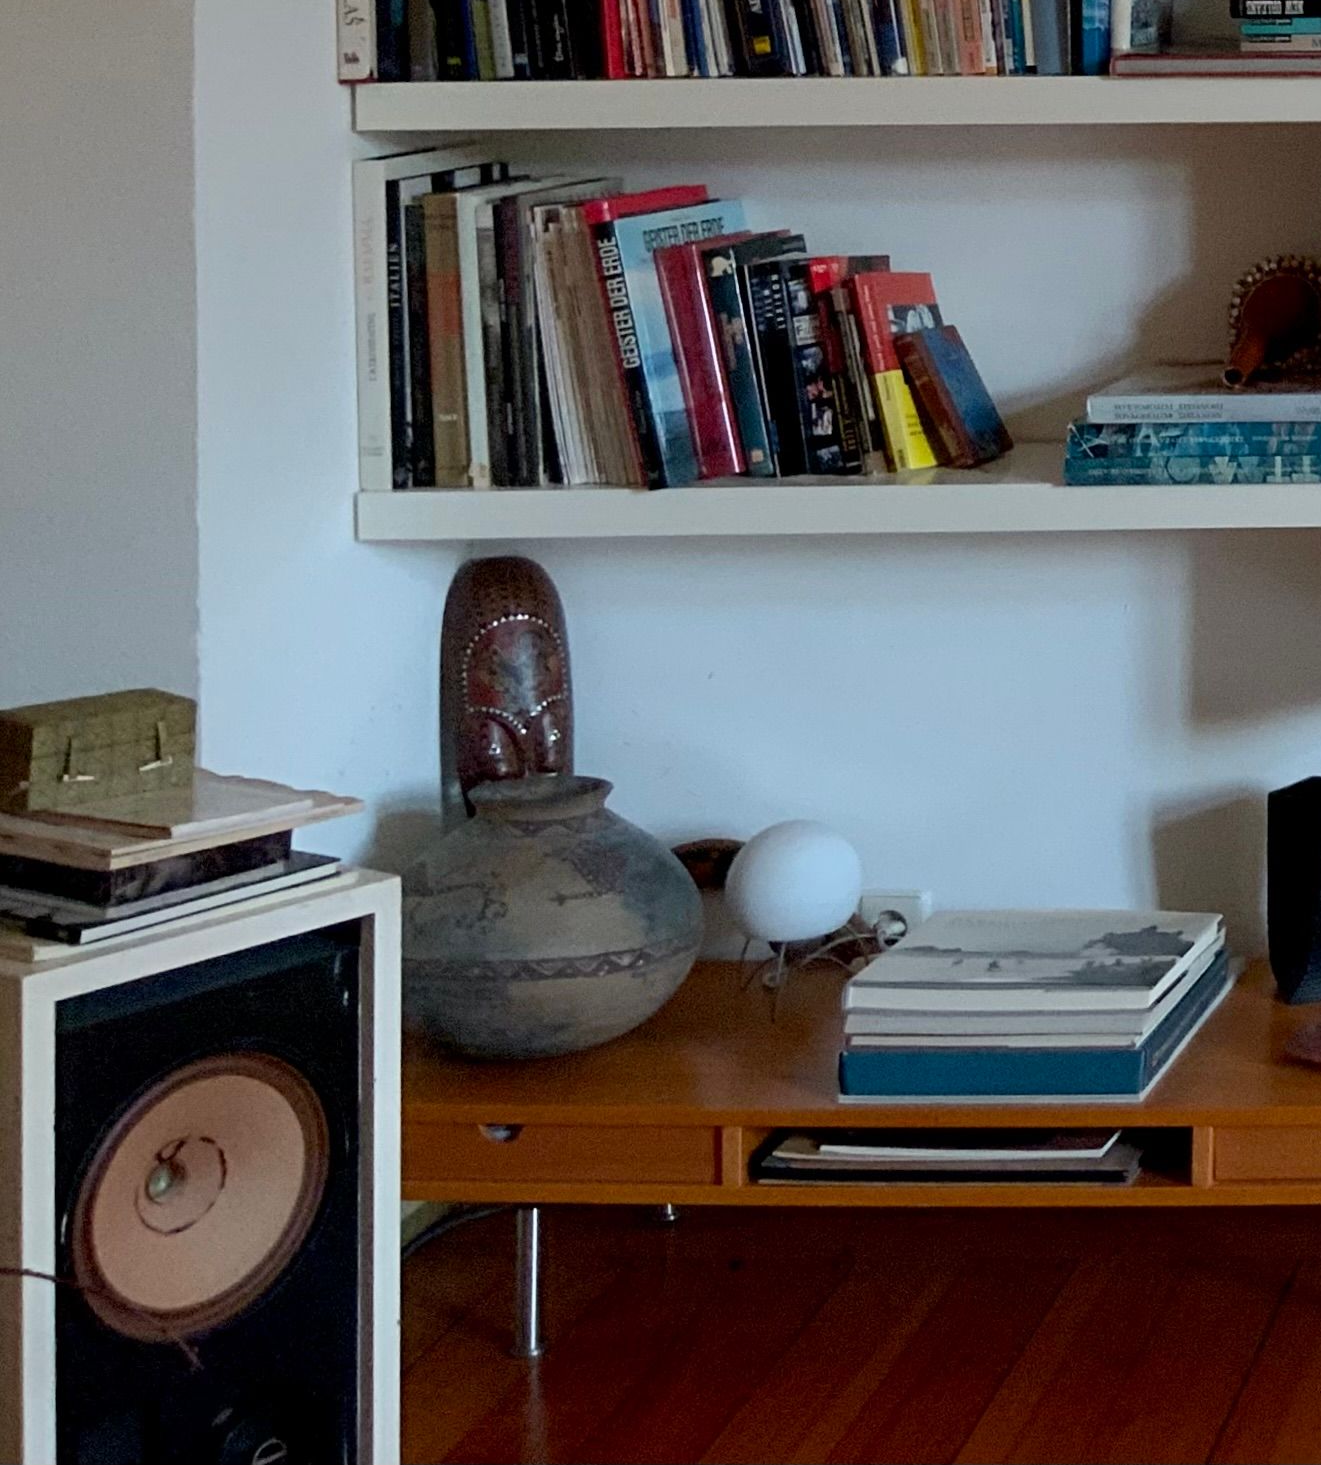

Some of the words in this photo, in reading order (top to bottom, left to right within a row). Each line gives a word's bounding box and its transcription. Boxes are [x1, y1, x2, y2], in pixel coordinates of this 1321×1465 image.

[389, 242, 400, 308] ITALIEN
[597, 236, 619, 275] ERDE
[606, 278, 628, 306] DER
[614, 310, 640, 369] GEISTER
